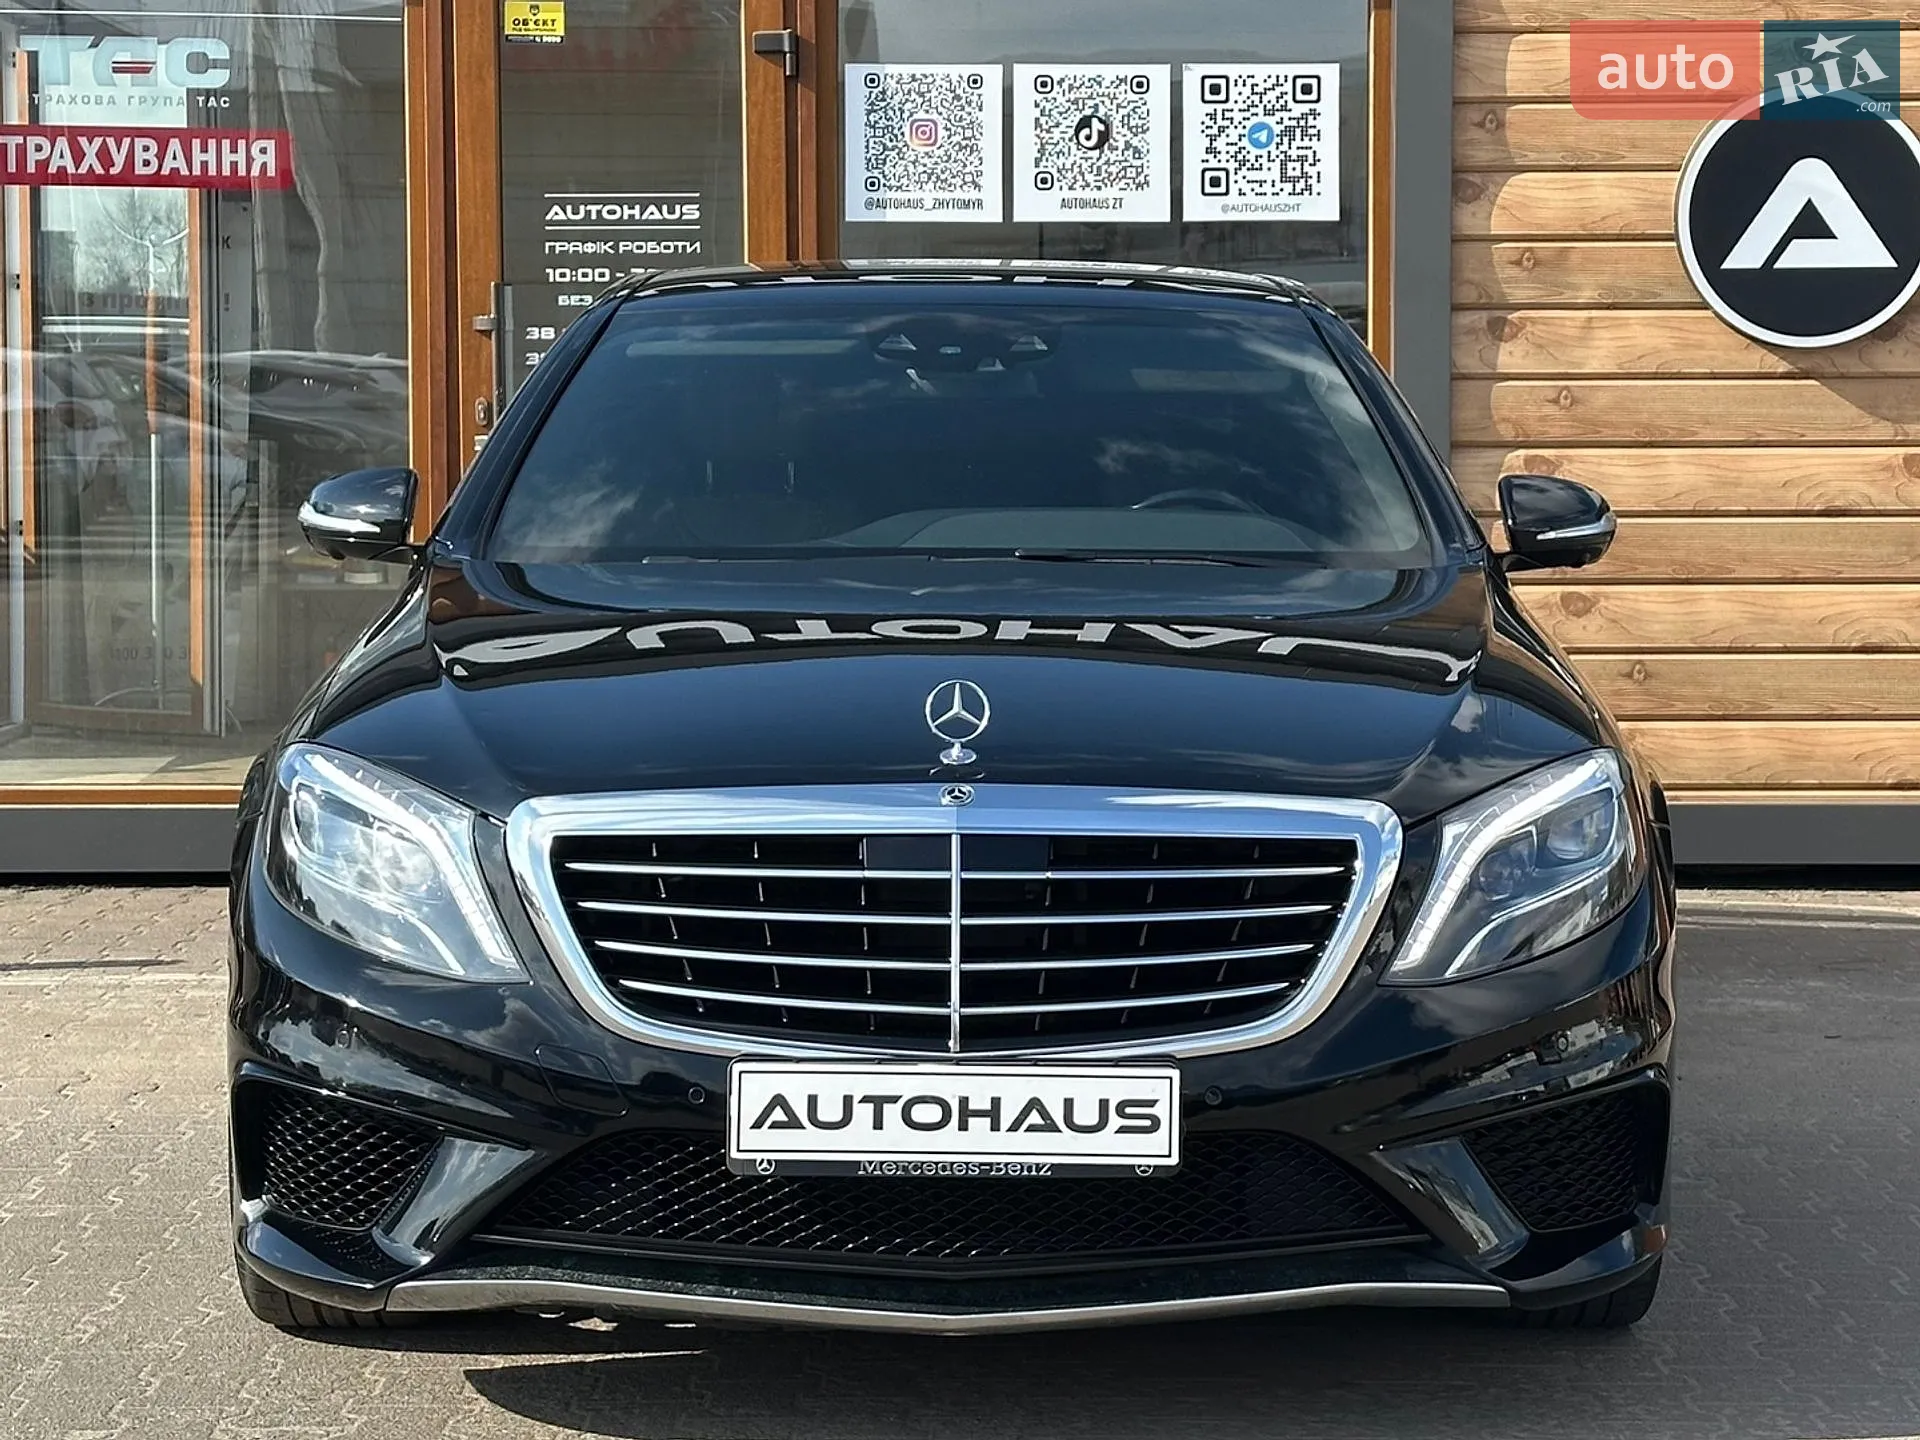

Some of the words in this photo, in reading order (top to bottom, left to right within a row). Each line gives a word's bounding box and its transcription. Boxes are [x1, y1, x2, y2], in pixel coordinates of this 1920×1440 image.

[127, 95, 185, 107] ГРУПА
[196, 96, 230, 108] ТАС
[864, 197, 983, 211] @AUTOHAUS_ZHYTOMYR
[1060, 197, 1110, 210] AUTOHAUS
[1112, 197, 1124, 210] ZT
[545, 204, 700, 221] AUTOHAUS
[545, 241, 615, 254] ГРАФІК
[619, 241, 701, 254] РОБОТИ
[545, 268, 610, 283] 10:00
[558, 295, 593, 306] БЕЗ
[749, 1092, 1161, 1134] AUTOHAUS
[857, 1161, 1052, 1176] Mercedes-Benz
